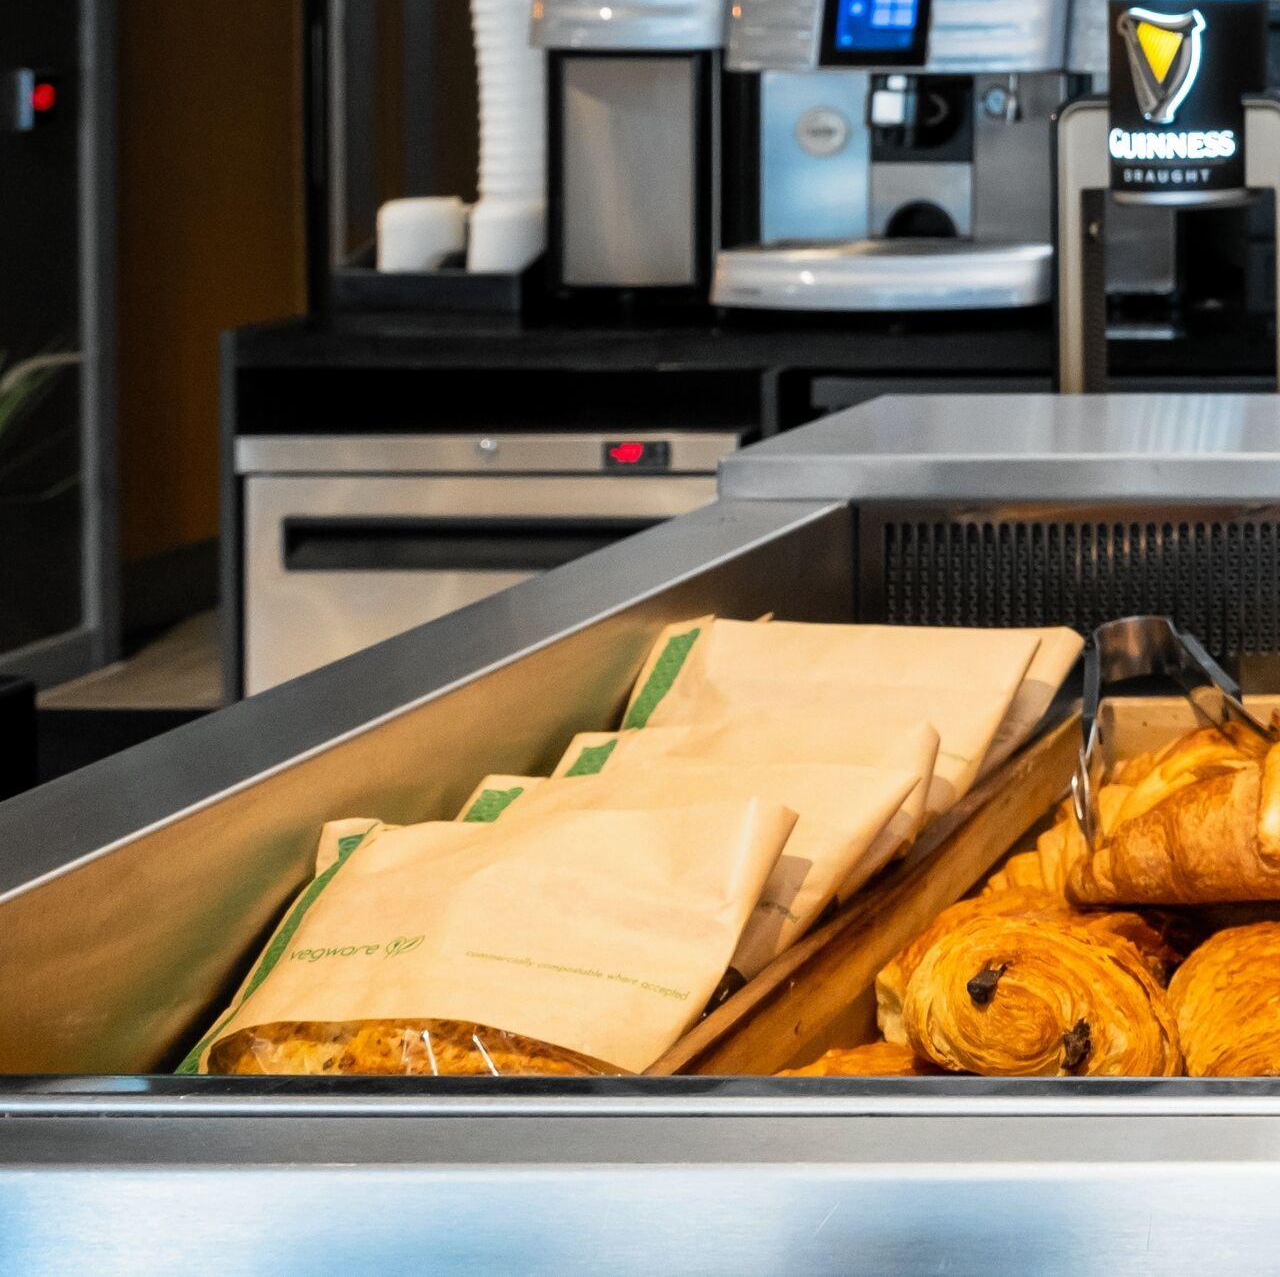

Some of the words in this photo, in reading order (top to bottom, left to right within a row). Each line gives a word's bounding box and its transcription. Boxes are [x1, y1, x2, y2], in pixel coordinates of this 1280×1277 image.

[1108, 126, 1237, 160] GUINNESS
[1123, 168, 1211, 184] DRAUGHT
[289, 934, 380, 963] vegware
